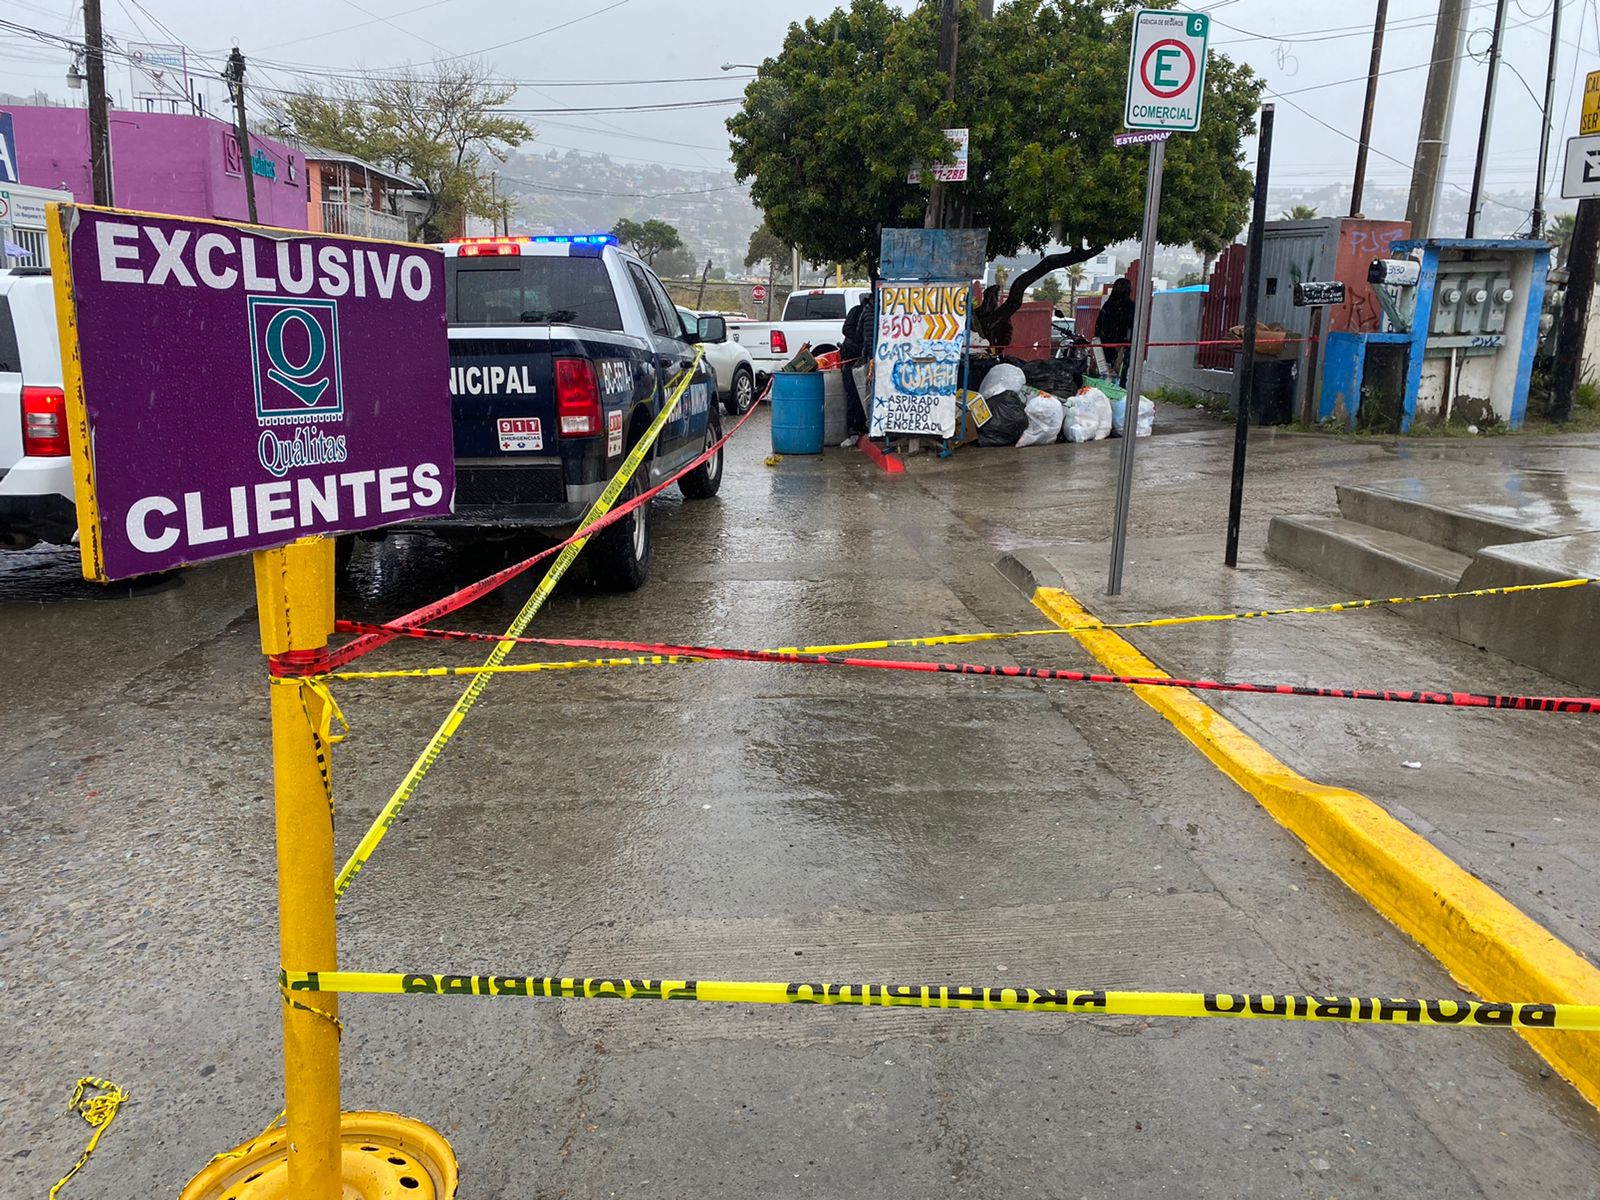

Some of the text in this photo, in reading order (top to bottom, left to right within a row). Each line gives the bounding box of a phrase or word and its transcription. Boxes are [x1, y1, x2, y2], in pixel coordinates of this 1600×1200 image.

[1193, 18, 1203, 31] 6
[1154, 49, 1181, 87] E
[1132, 104, 1193, 120] COMERCIAL
[95, 220, 432, 301] EXCLUSIVO
[881, 287, 968, 316] PARKING
[878, 342, 912, 360] CAR
[900, 363, 957, 389] WASH
[888, 396, 940, 407] ASPIRADO
[888, 405, 931, 414] LAVADO
[502, 421, 537, 431] 911
[887, 413, 929, 423] PULIDO
[258, 426, 348, 477] Quálitas
[125, 462, 443, 553] CLIENTES
